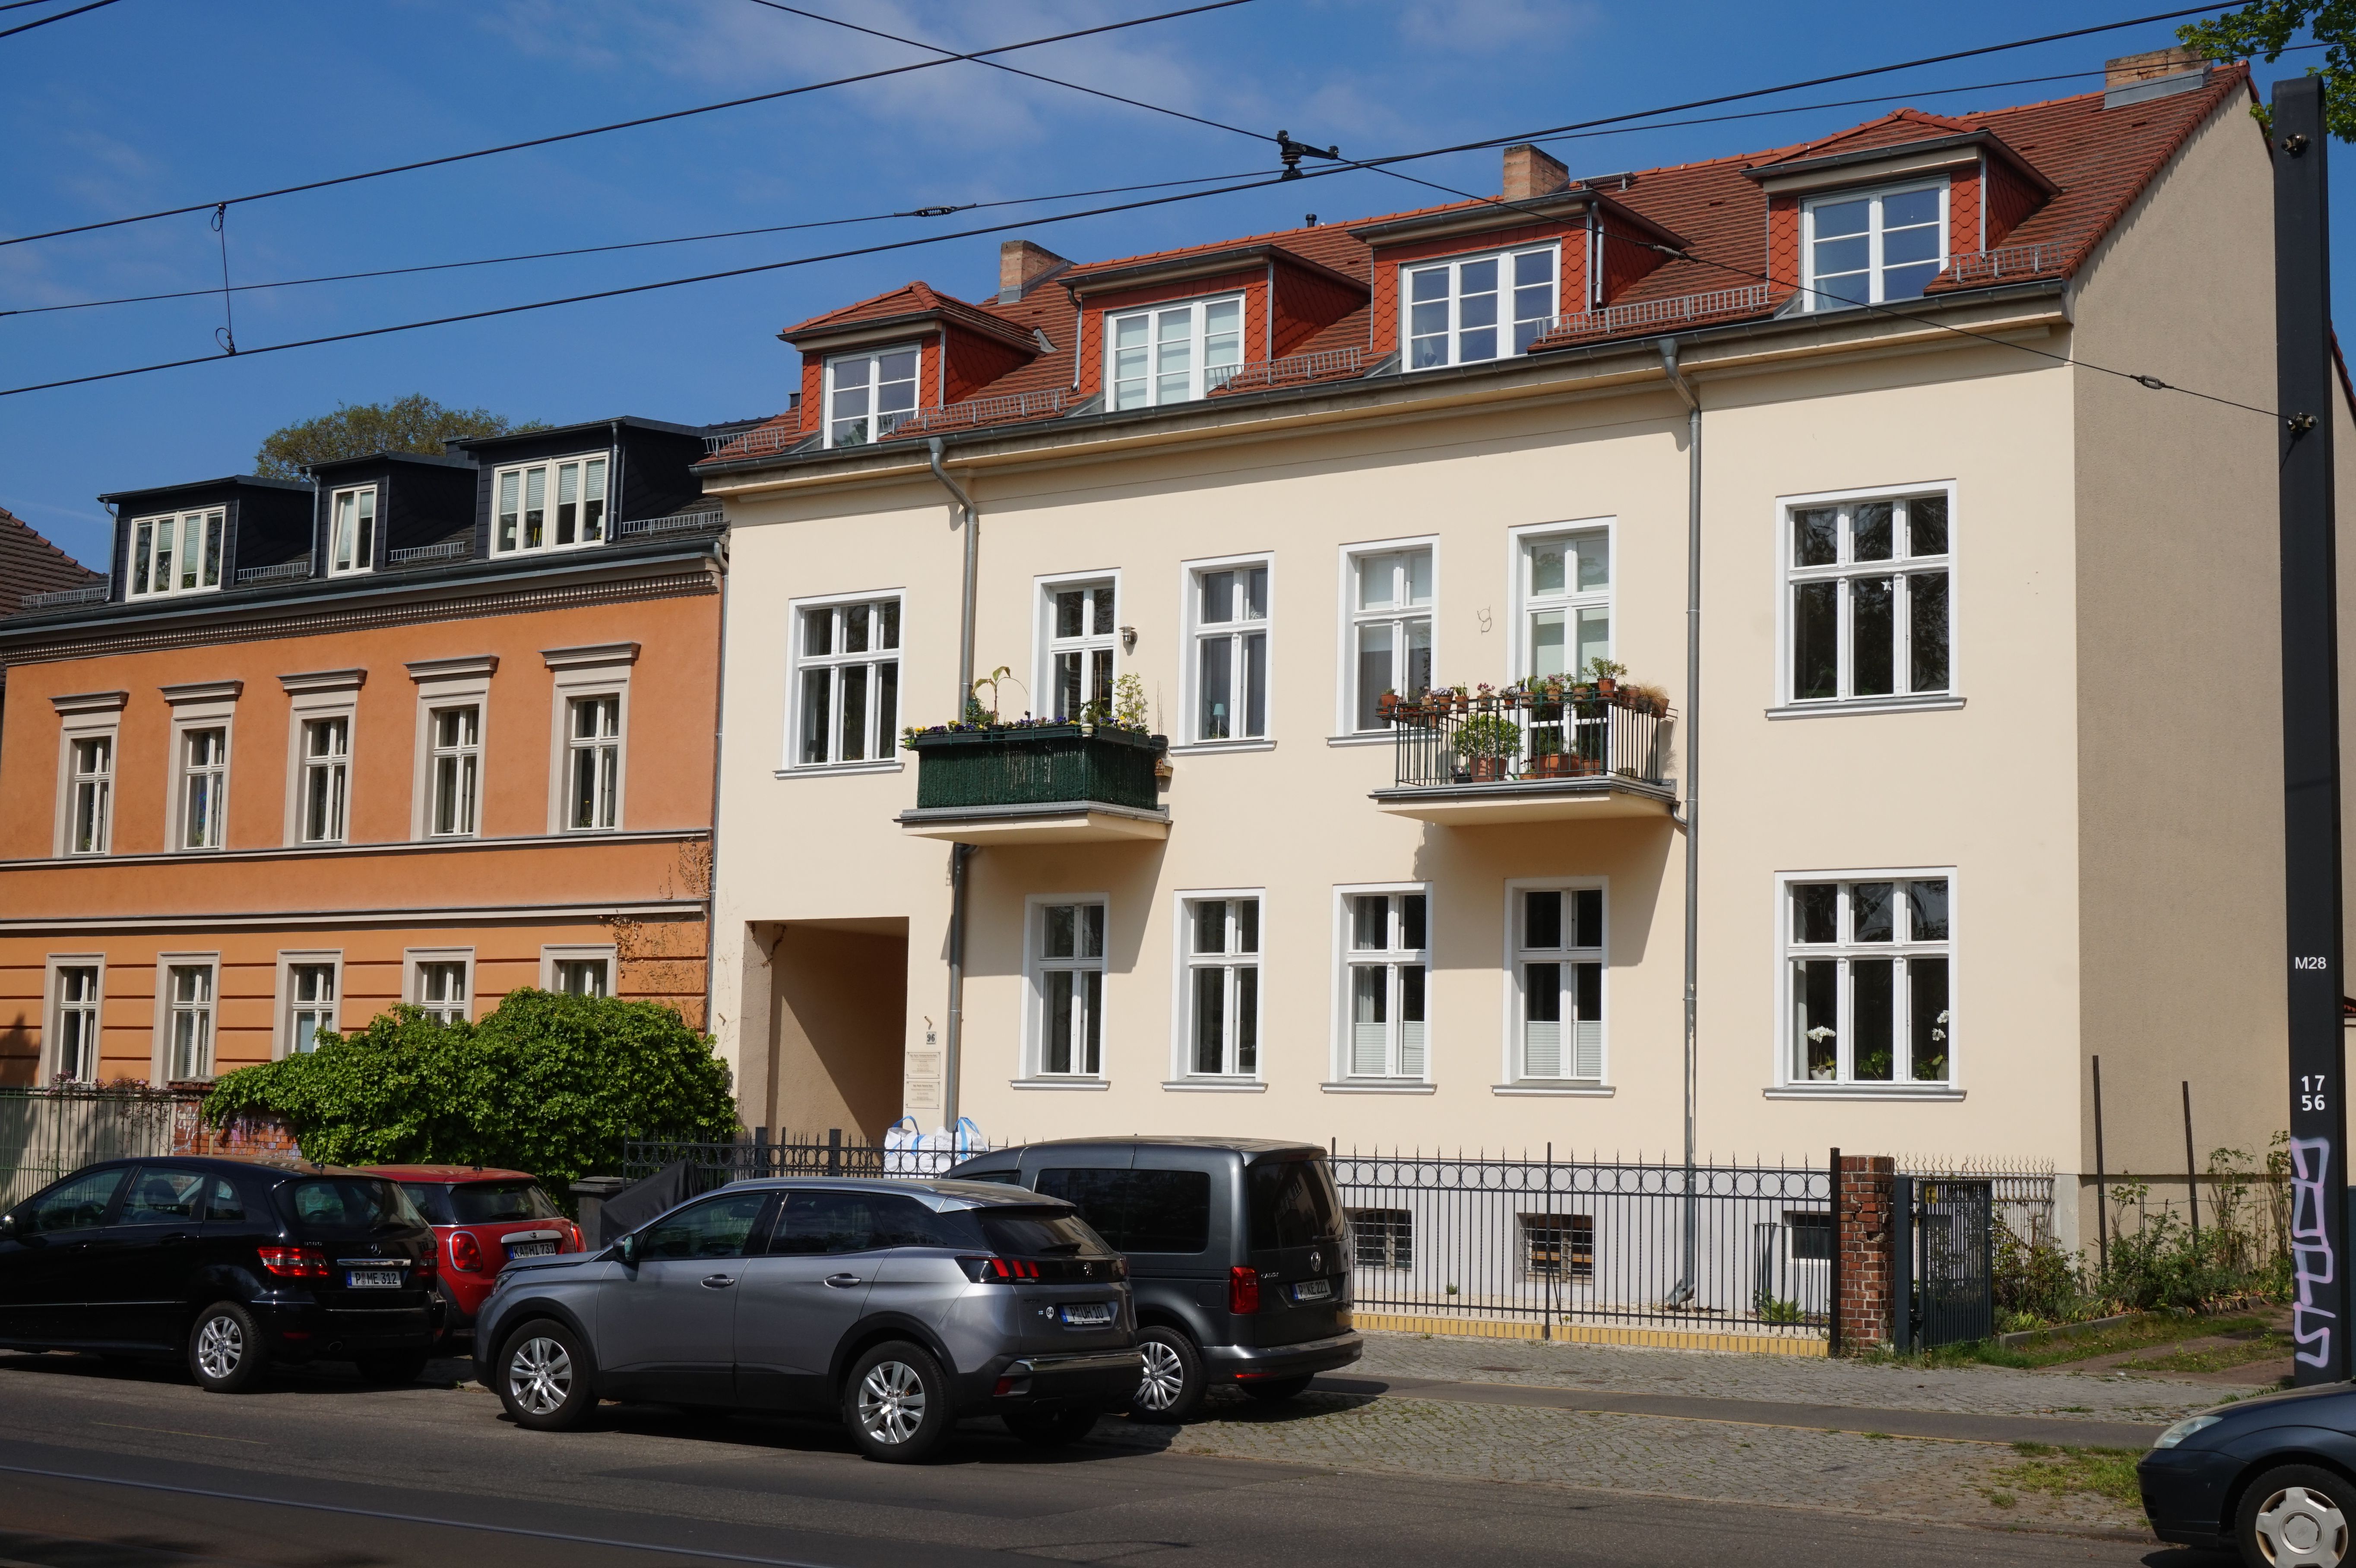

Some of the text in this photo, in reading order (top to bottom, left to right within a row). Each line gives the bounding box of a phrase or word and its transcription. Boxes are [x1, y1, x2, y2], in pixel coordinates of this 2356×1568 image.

[2295, 956, 2327, 970] M28
[927, 1034, 935, 1042] 96
[2301, 1075, 2325, 1092] 17
[2301, 1094, 2325, 1111] 56
[513, 1246, 525, 1258] KA
[529, 1245, 539, 1256] HI
[540, 1243, 555, 1255] 731
[355, 1273, 361, 1284] P
[367, 1273, 379, 1284] ME
[381, 1273, 397, 1284] 312
[1298, 1280, 1328, 1296] P KE 221
[1069, 1306, 1076, 1320] P
[1080, 1306, 1093, 1320] UH
[1092, 1306, 1104, 1319] 10
